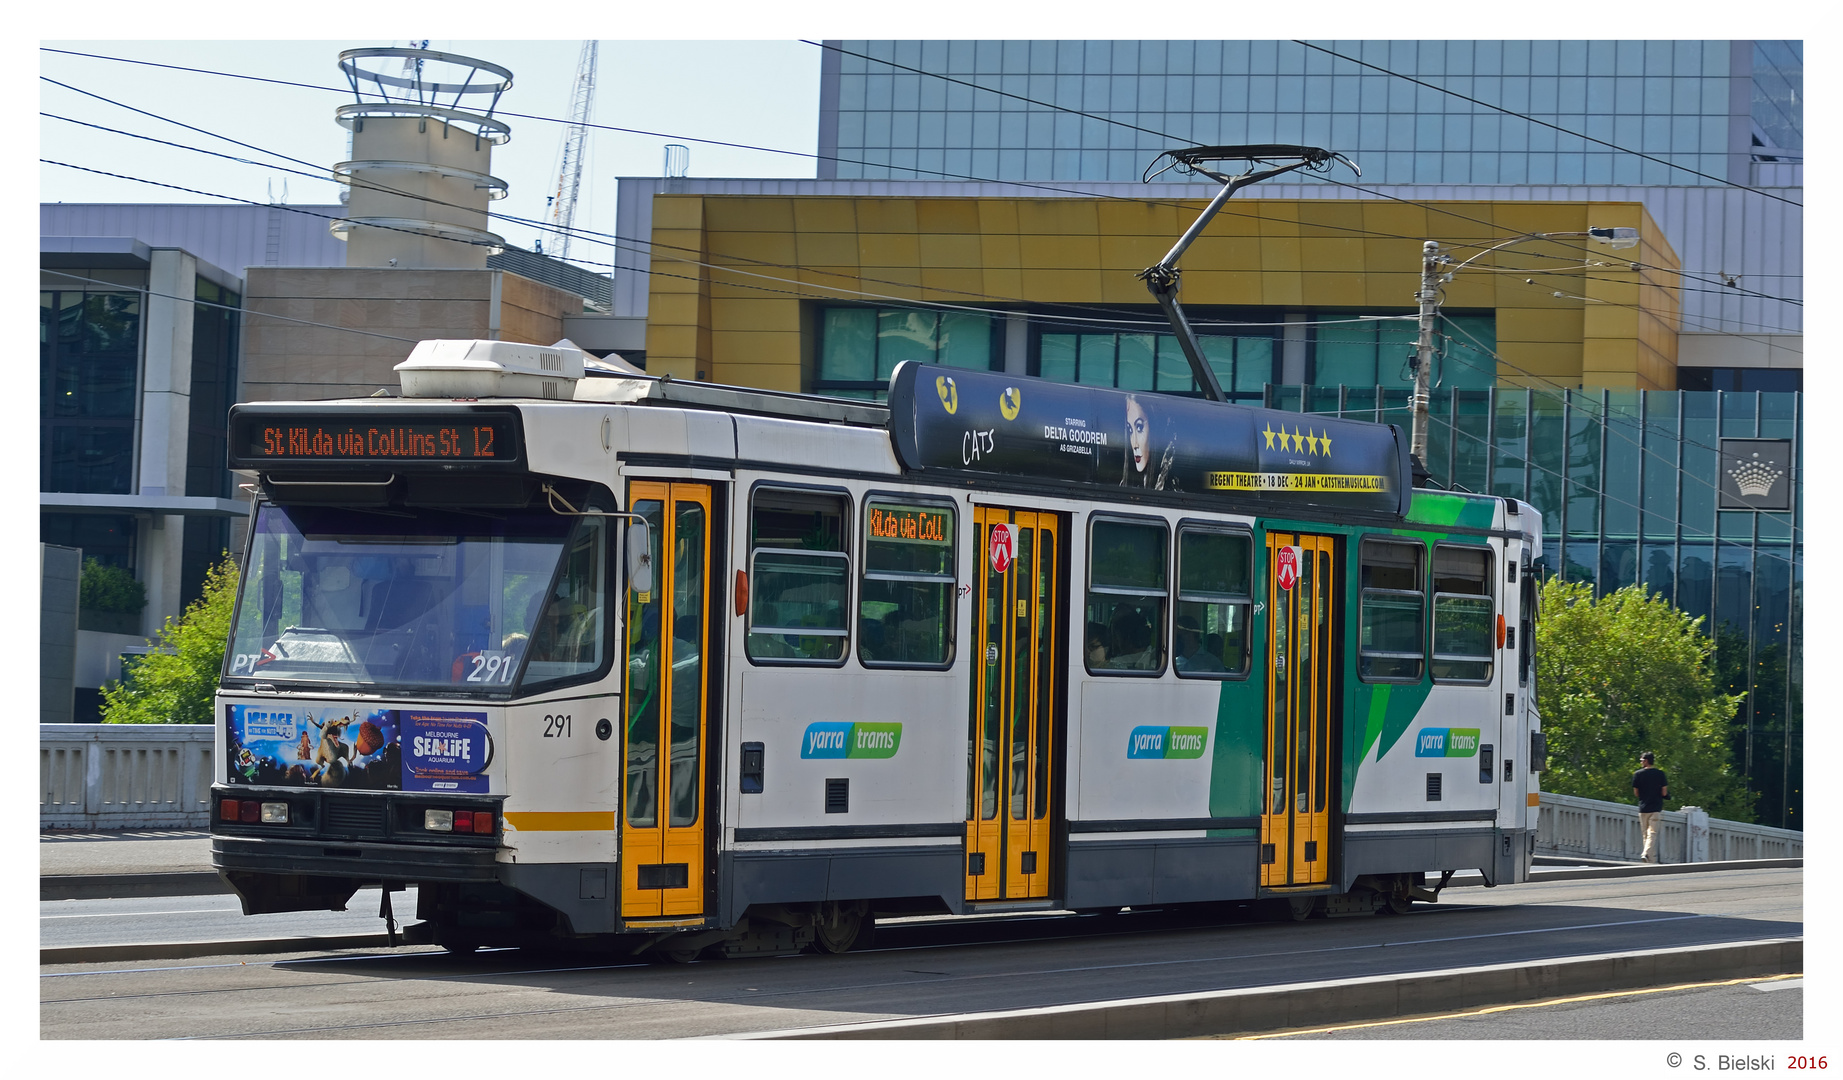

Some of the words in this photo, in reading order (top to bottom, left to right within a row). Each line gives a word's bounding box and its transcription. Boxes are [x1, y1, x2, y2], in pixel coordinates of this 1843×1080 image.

[1065, 417, 1086, 428] STARRING
[264, 428, 285, 455] St
[289, 428, 333, 455] Kilda
[337, 428, 364, 455] via
[368, 428, 436, 456] Collins
[440, 428, 460, 456] St
[473, 427, 494, 457] 12
[1044, 425, 1068, 440] DELTA
[1069, 428, 1108, 446] GOODREM
[962, 428, 995, 466] CATS
[1060, 444, 1066, 452] AS
[1066, 445, 1092, 454] GRIZABELLA
[1210, 474, 1234, 486] REGENT
[1236, 474, 1262, 487] THEATRE
[1268, 475, 1276, 487] 18
[1278, 476, 1288, 488] DEC
[1294, 476, 1302, 488] 24
[1304, 476, 1316, 488] JAN
[1320, 476, 1384, 490] CATSTHEMUSICAL.COM
[870, 508, 898, 538] Kilda
[900, 513, 916, 538] via
[918, 512, 943, 540] Coll
[994, 530, 1010, 543] STOP
[1280, 552, 1294, 564] STOP
[467, 655, 512, 682] 291
[248, 712, 268, 724] ICE
[269, 712, 292, 726] AGE
[543, 714, 572, 738] 291
[414, 736, 441, 757] SEA
[808, 731, 844, 754] yarra
[857, 728, 894, 748] trams
[1134, 734, 1162, 754] yarra
[1172, 732, 1202, 750] trams
[1420, 734, 1443, 753] yarra
[1452, 733, 1476, 750] trams
